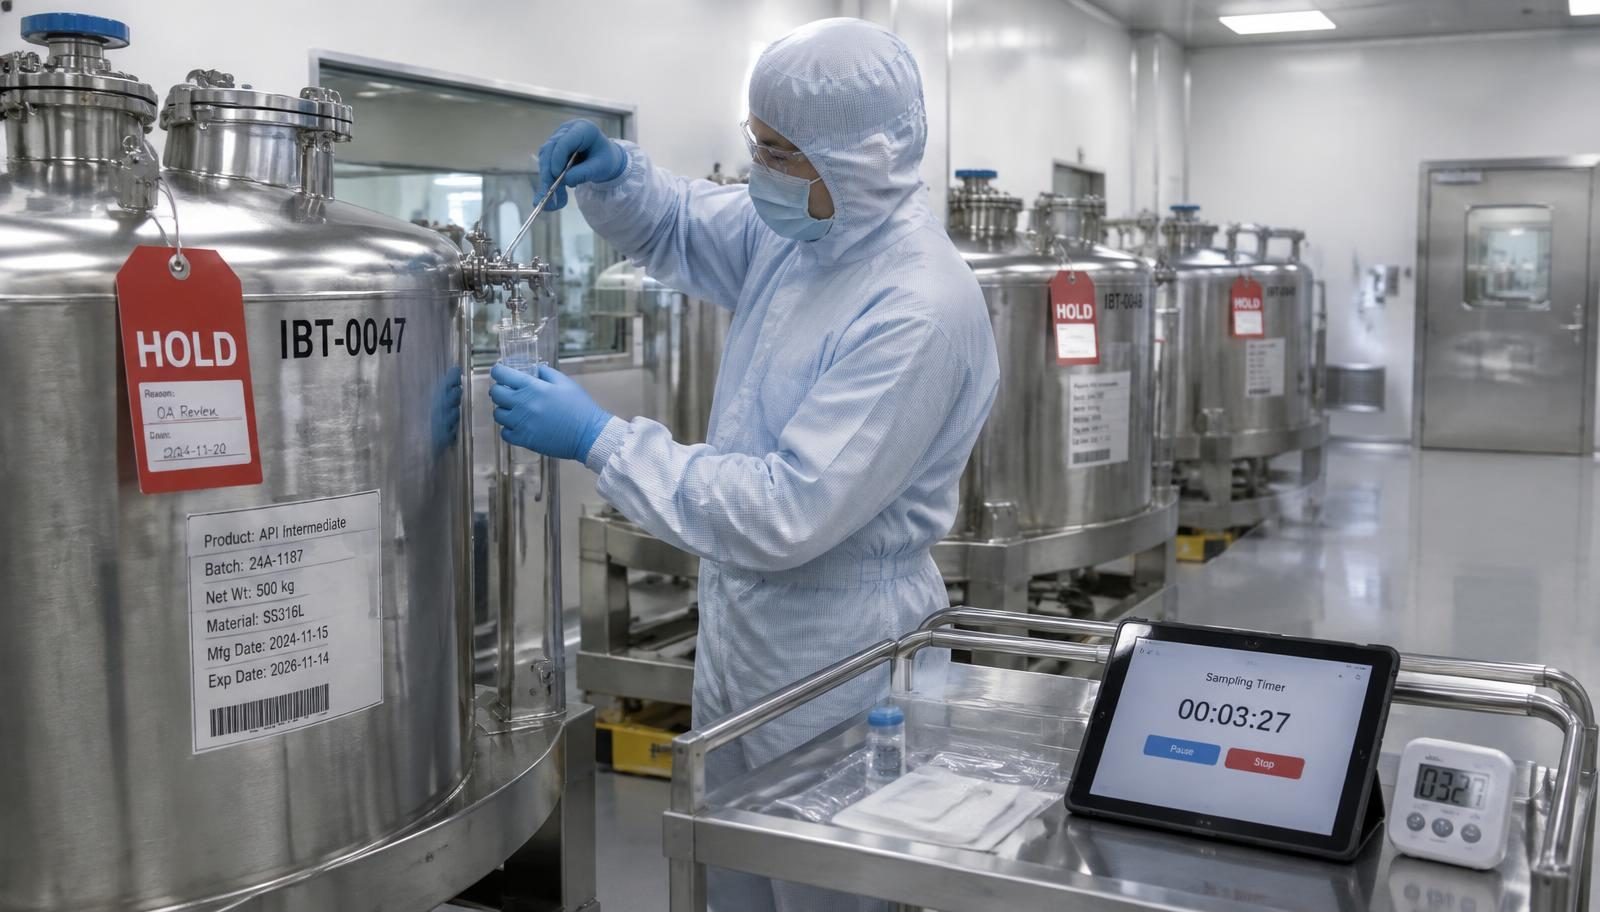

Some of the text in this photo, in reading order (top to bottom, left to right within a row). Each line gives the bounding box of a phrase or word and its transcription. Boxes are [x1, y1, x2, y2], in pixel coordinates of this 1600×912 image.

[1056, 303, 1093, 320] HOLD
[136, 330, 237, 368] HOLD
[280, 317, 407, 359] IBT-0047
[204, 517, 347, 548] Product: API Intermediate
[205, 549, 303, 577] Batch: 24A-1187
[206, 580, 295, 605] Net Wt: 500 kg
[206, 604, 305, 633] Material: SS316L
[207, 625, 329, 662] Mfg Date: 2024-11-15
[208, 651, 330, 690] Exp Date: 2026-11-14
[1206, 672, 1286, 692] Sampling Timer
[1178, 698, 1291, 733] 00:03:27
[1169, 744, 1194, 756] Pause
